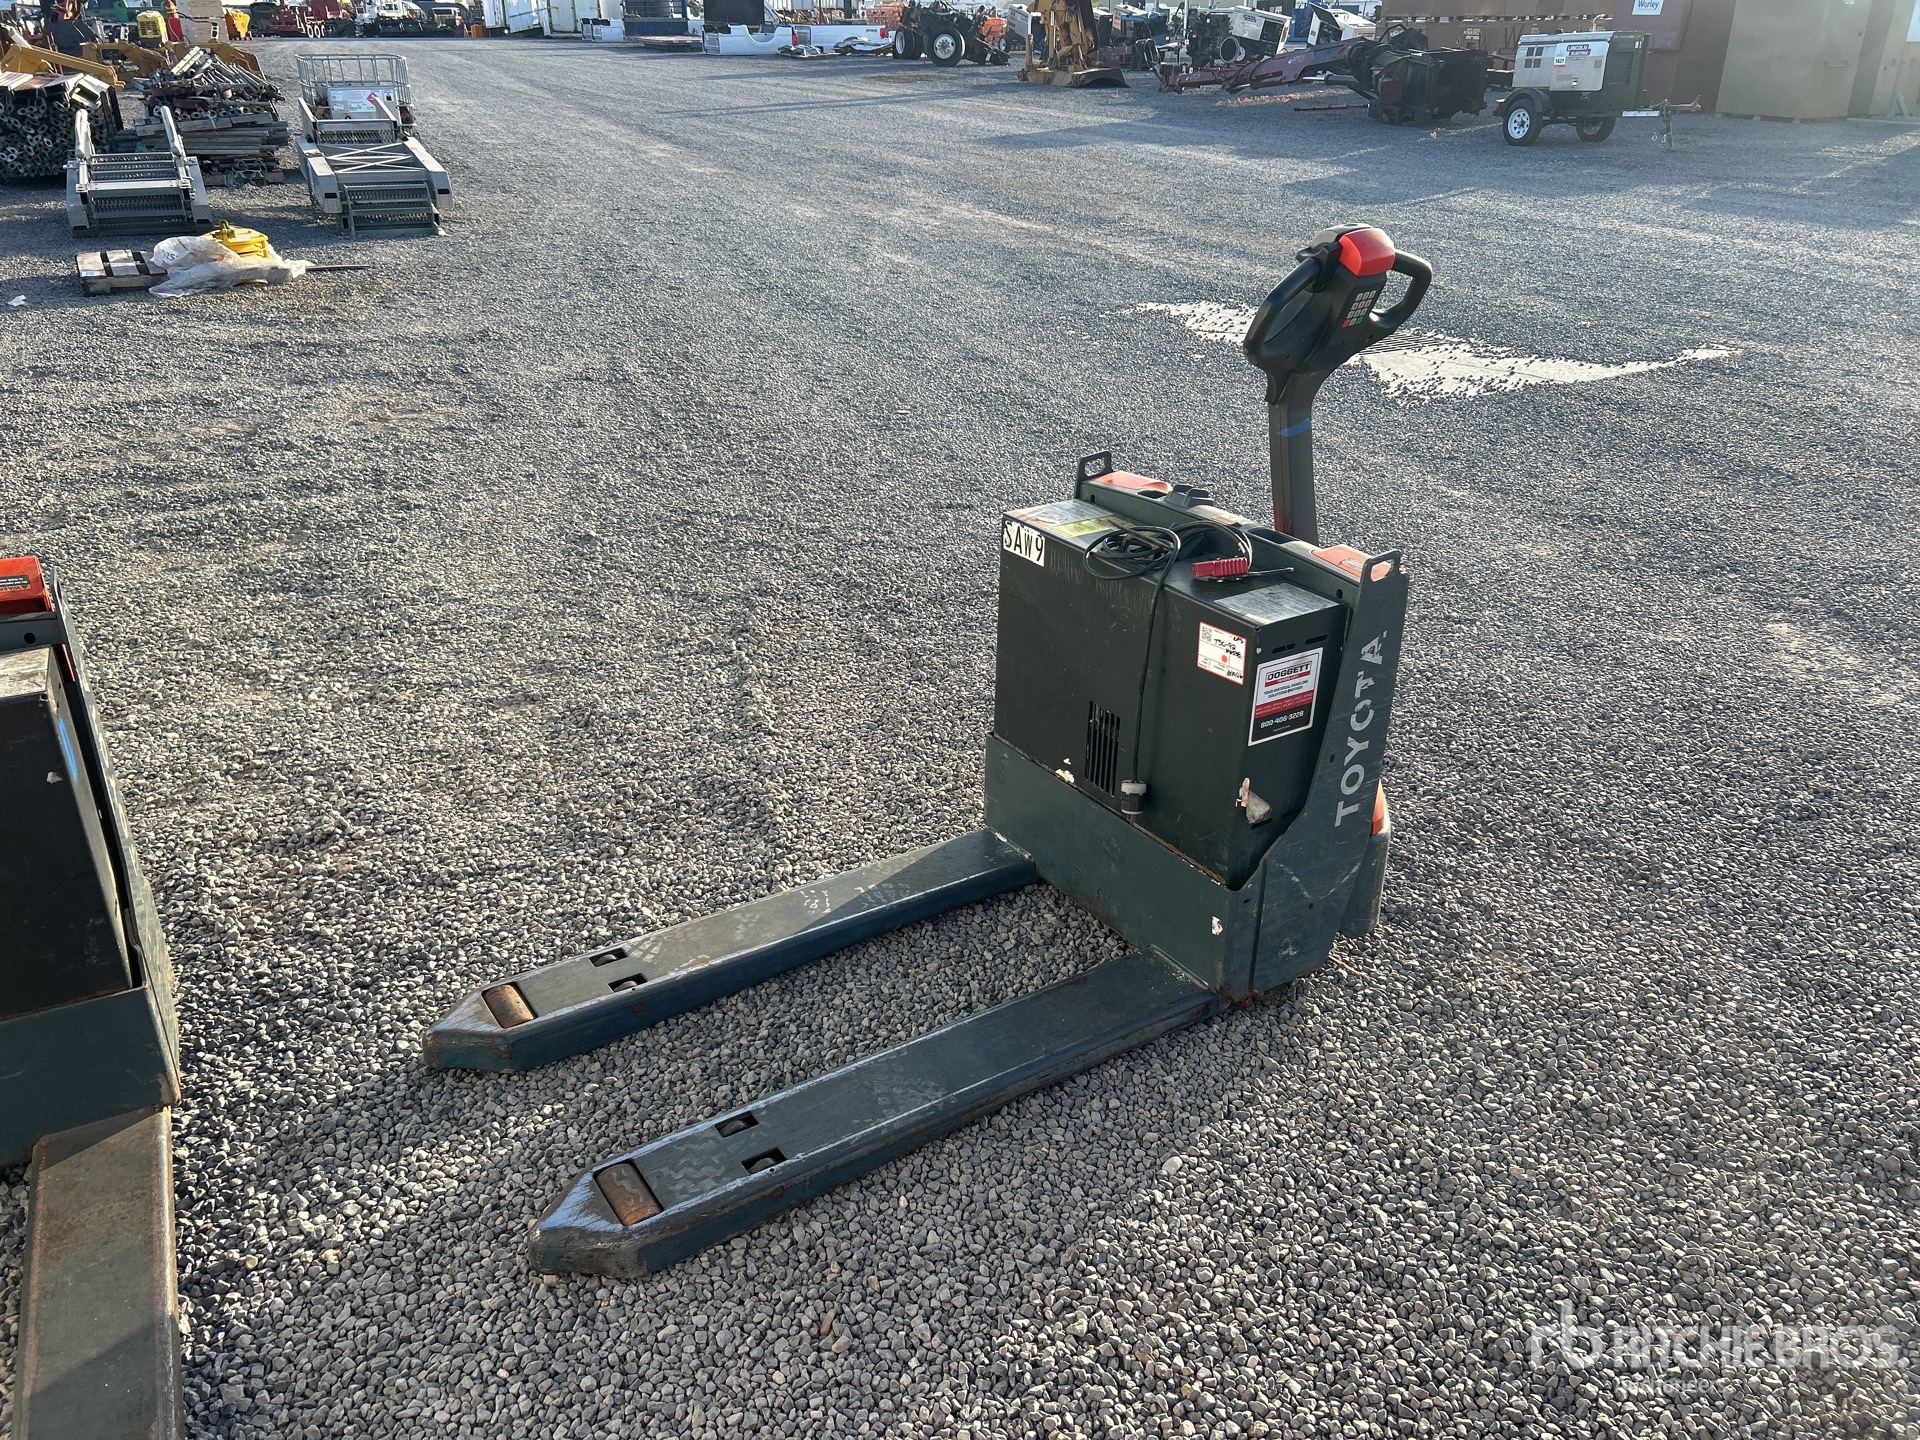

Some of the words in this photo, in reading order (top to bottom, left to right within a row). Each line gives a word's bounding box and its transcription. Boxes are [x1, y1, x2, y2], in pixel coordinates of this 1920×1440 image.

[1638, 0, 1659, 10] Worley
[1267, 663, 1310, 681] DOGGETT
[1335, 630, 1387, 828] TOYOTA
